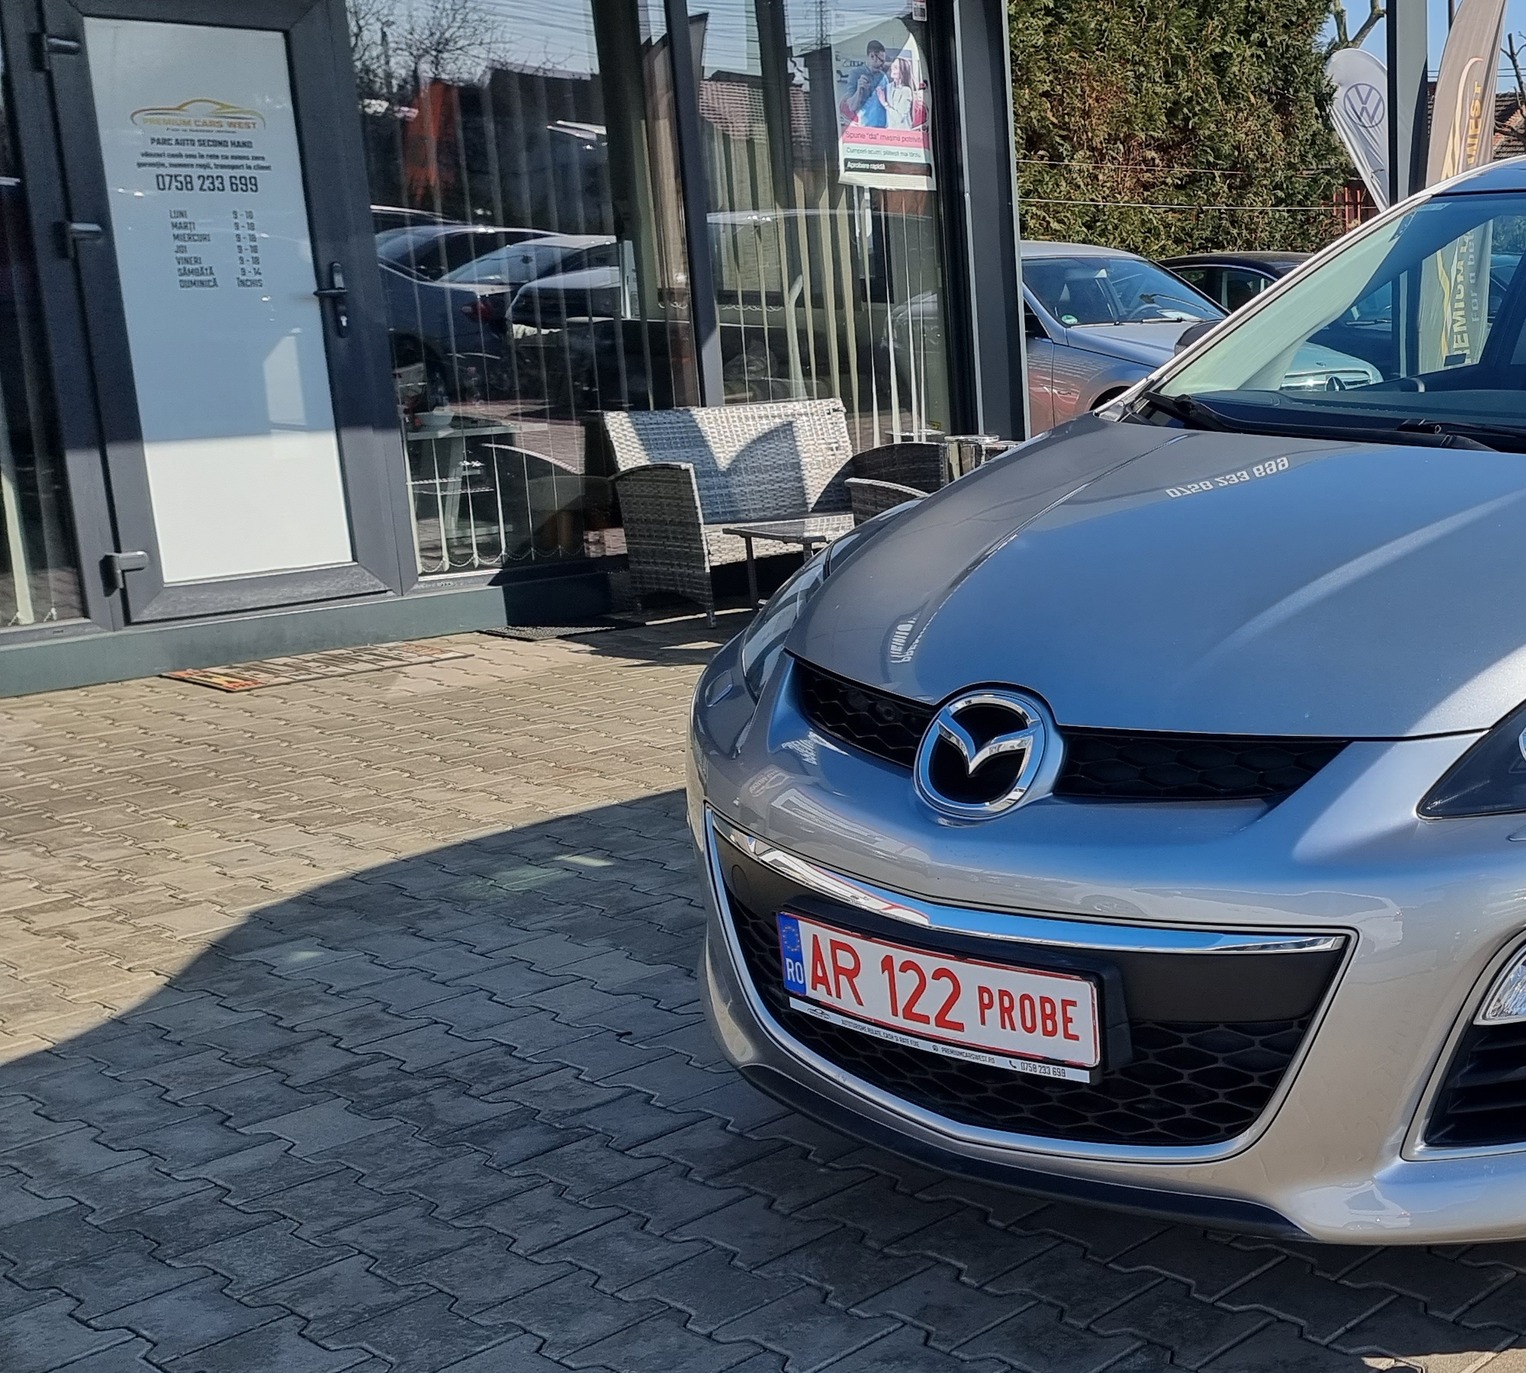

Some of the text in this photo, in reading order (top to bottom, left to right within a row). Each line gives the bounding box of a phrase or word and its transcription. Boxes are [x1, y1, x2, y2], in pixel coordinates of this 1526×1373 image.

[143, 118, 257, 129] PREMIUM CARS WEST
[1466, 80, 1482, 165] WEST
[150, 137, 253, 149] PARC AUTO SECOND HAND
[155, 173, 258, 193] 0758 233 699
[169, 209, 187, 219] LUNI
[174, 244, 188, 254] JOI
[175, 256, 202, 265] VINERI
[786, 957, 806, 986] RO
[811, 933, 1081, 1042] AR 122 PROBE
[1020, 1061, 1066, 1078] 0758 233 699
